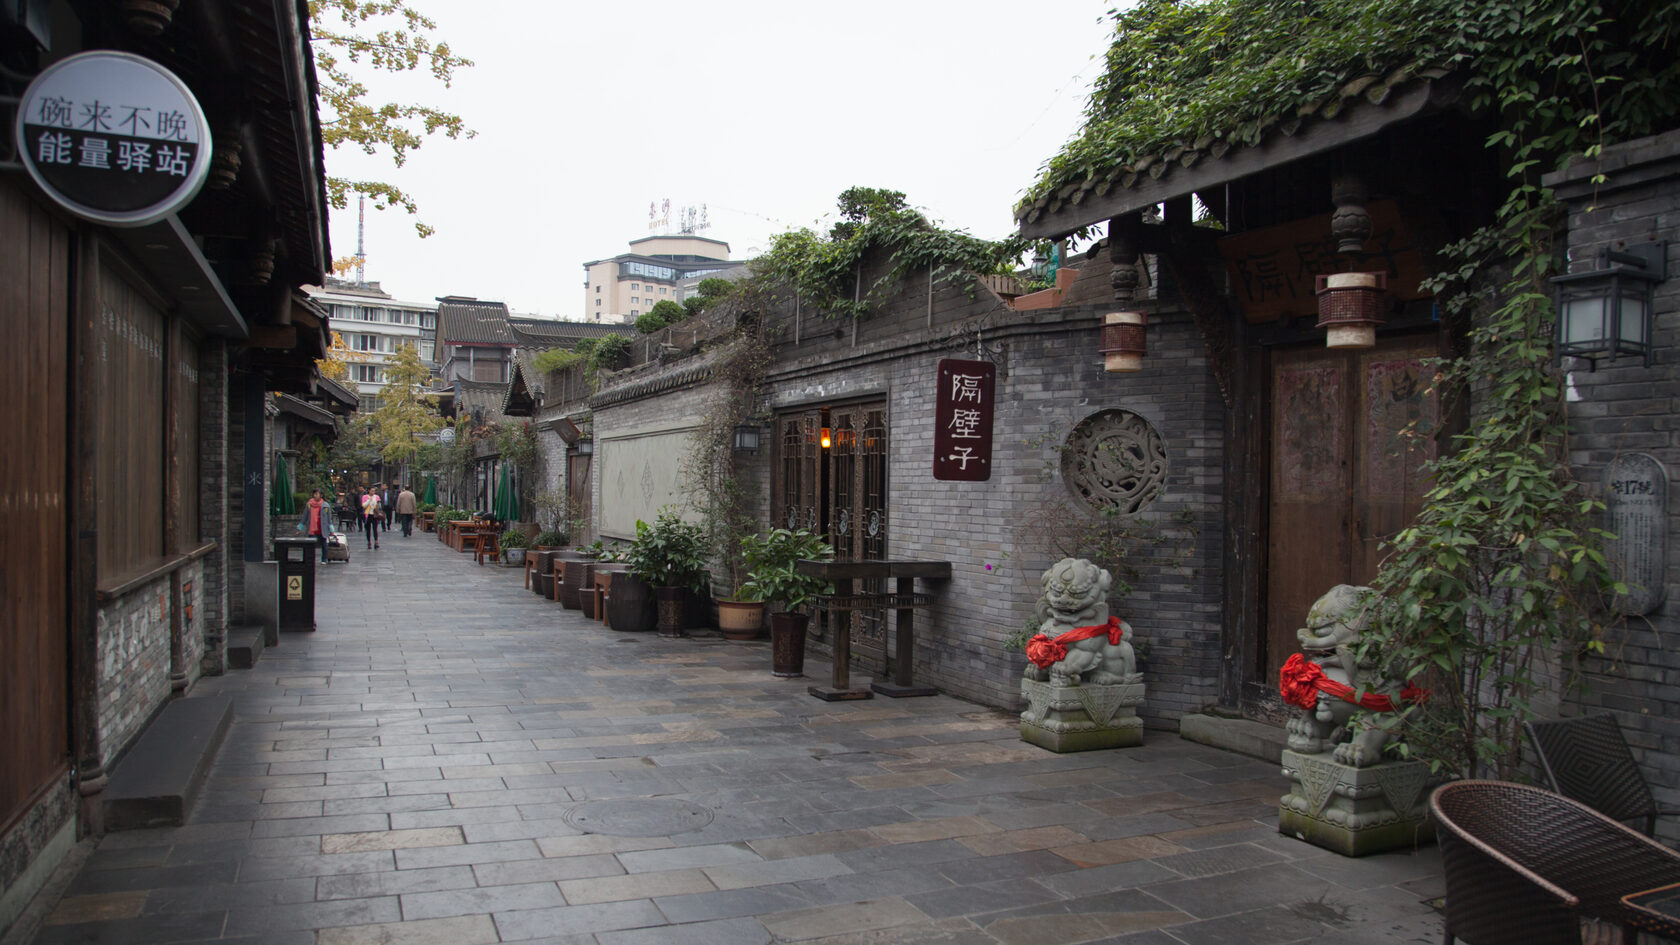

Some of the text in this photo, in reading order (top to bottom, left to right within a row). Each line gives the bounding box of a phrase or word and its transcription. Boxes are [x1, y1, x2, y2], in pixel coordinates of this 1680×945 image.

[39, 96, 188, 142] 碗来不晚
[38, 131, 191, 177] 能量驿站
[948, 374, 983, 470] 隔壁子
